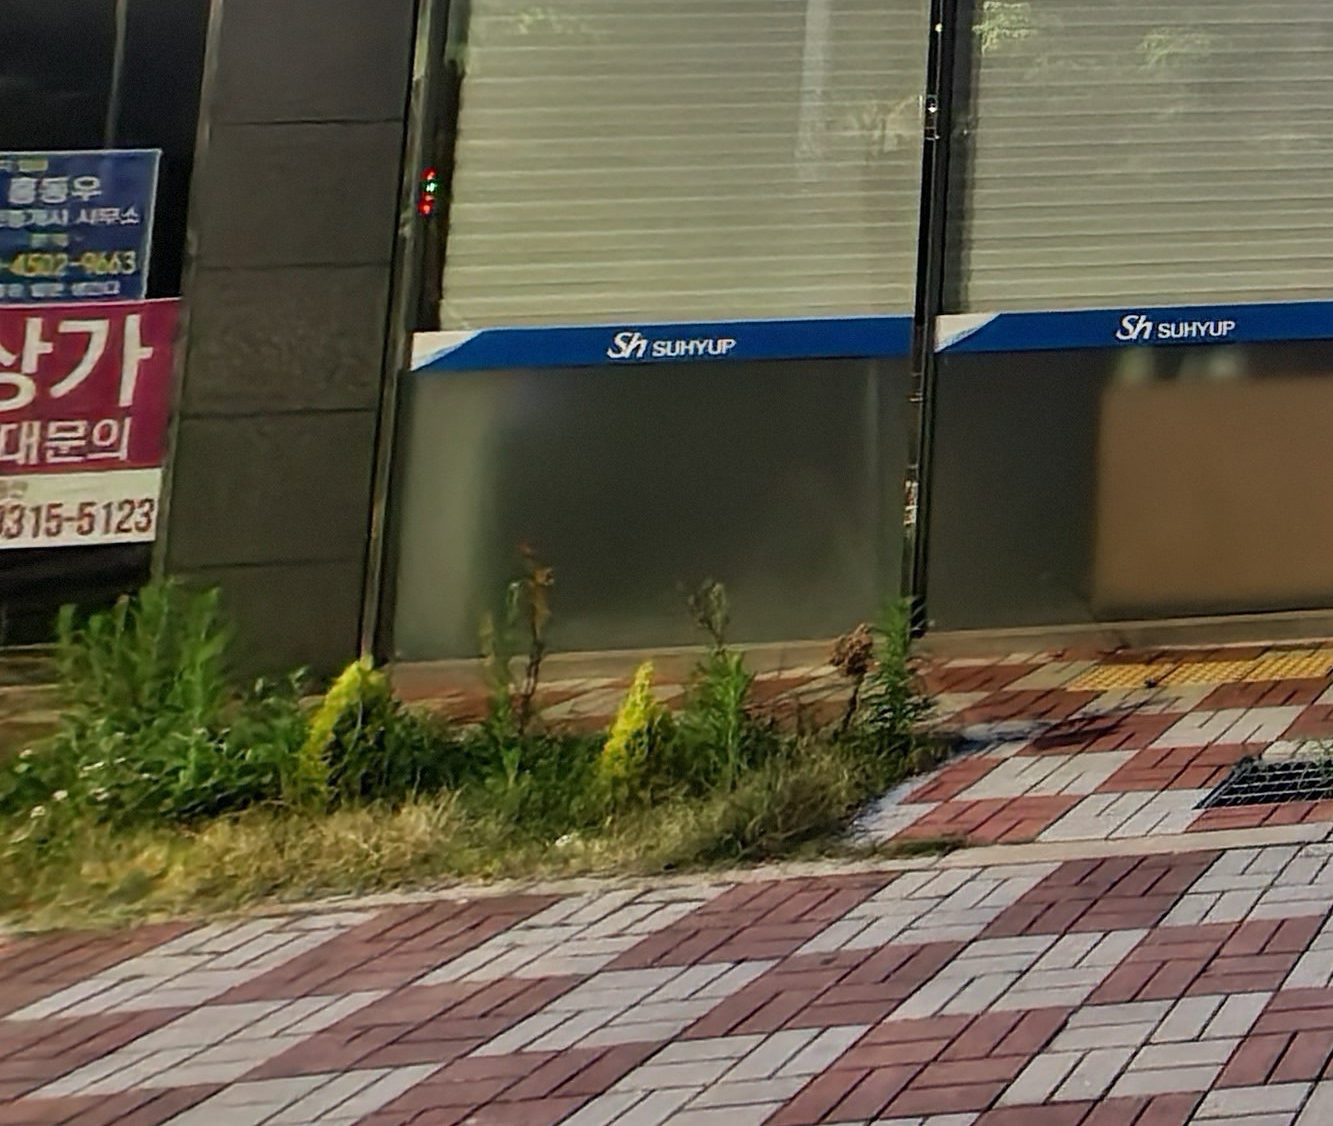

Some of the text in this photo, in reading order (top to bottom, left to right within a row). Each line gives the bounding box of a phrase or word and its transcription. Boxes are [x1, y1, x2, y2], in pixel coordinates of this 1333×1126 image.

[1115, 314, 1236, 341] Sh SUHYUP
[607, 331, 737, 359] Sh SUHYUP
